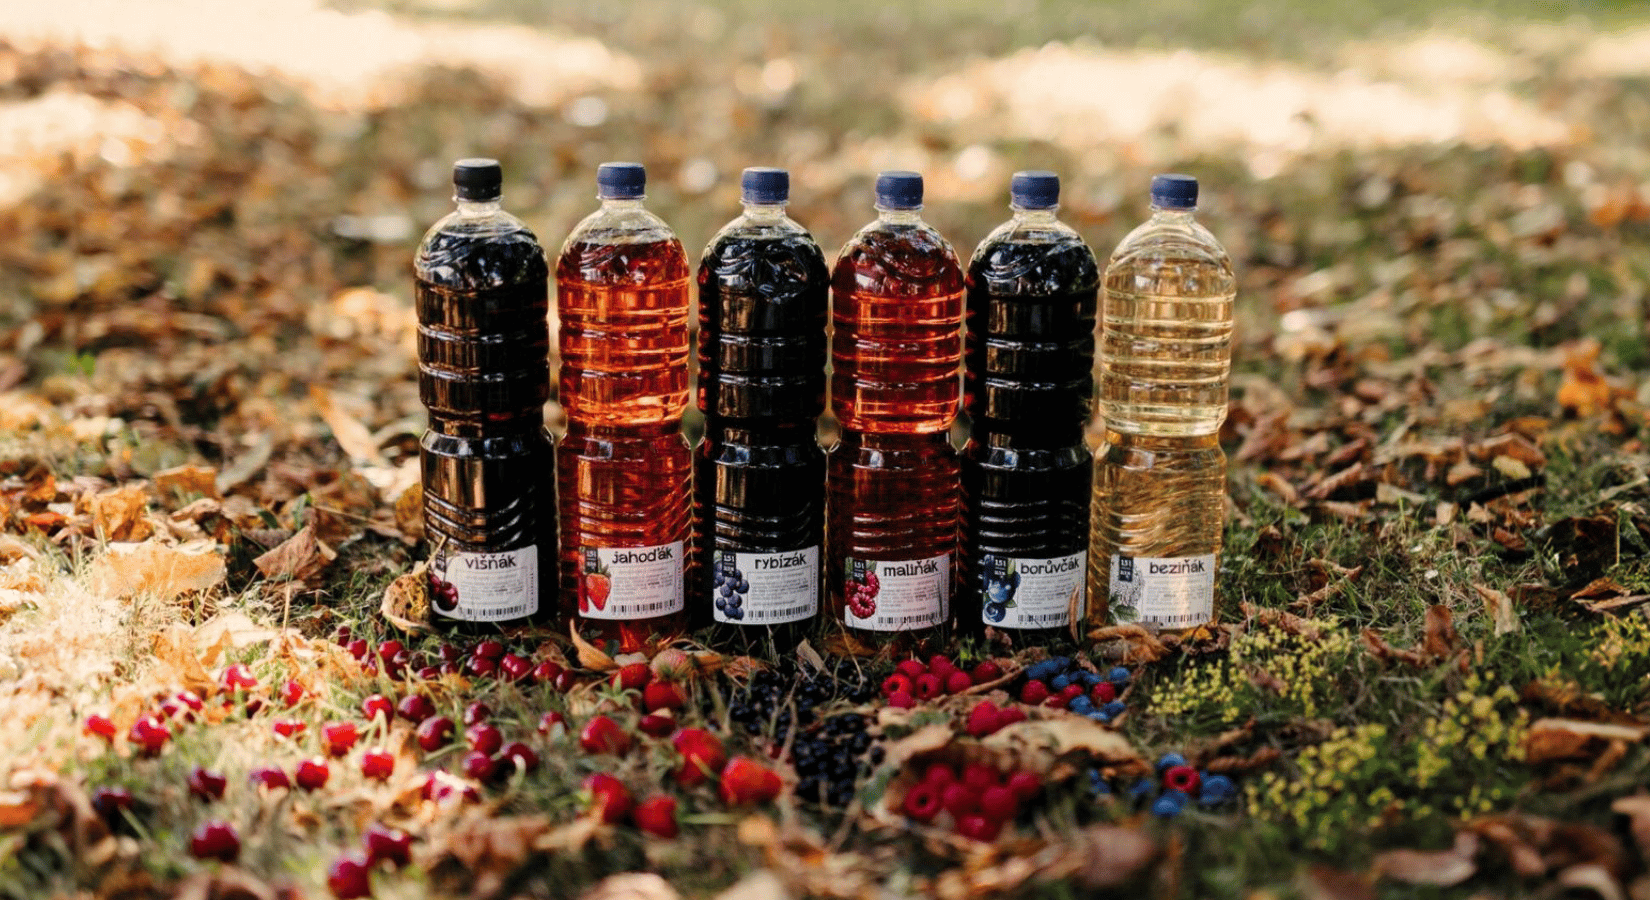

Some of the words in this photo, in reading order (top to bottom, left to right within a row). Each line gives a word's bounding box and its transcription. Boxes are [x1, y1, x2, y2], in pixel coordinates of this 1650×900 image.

[465, 554, 516, 570] višňák
[612, 546, 673, 564] jahoďák
[754, 552, 807, 569] rybízák
[883, 560, 938, 577] maliňák
[1020, 557, 1080, 575] borůvčák
[1149, 559, 1205, 574] beziňák
